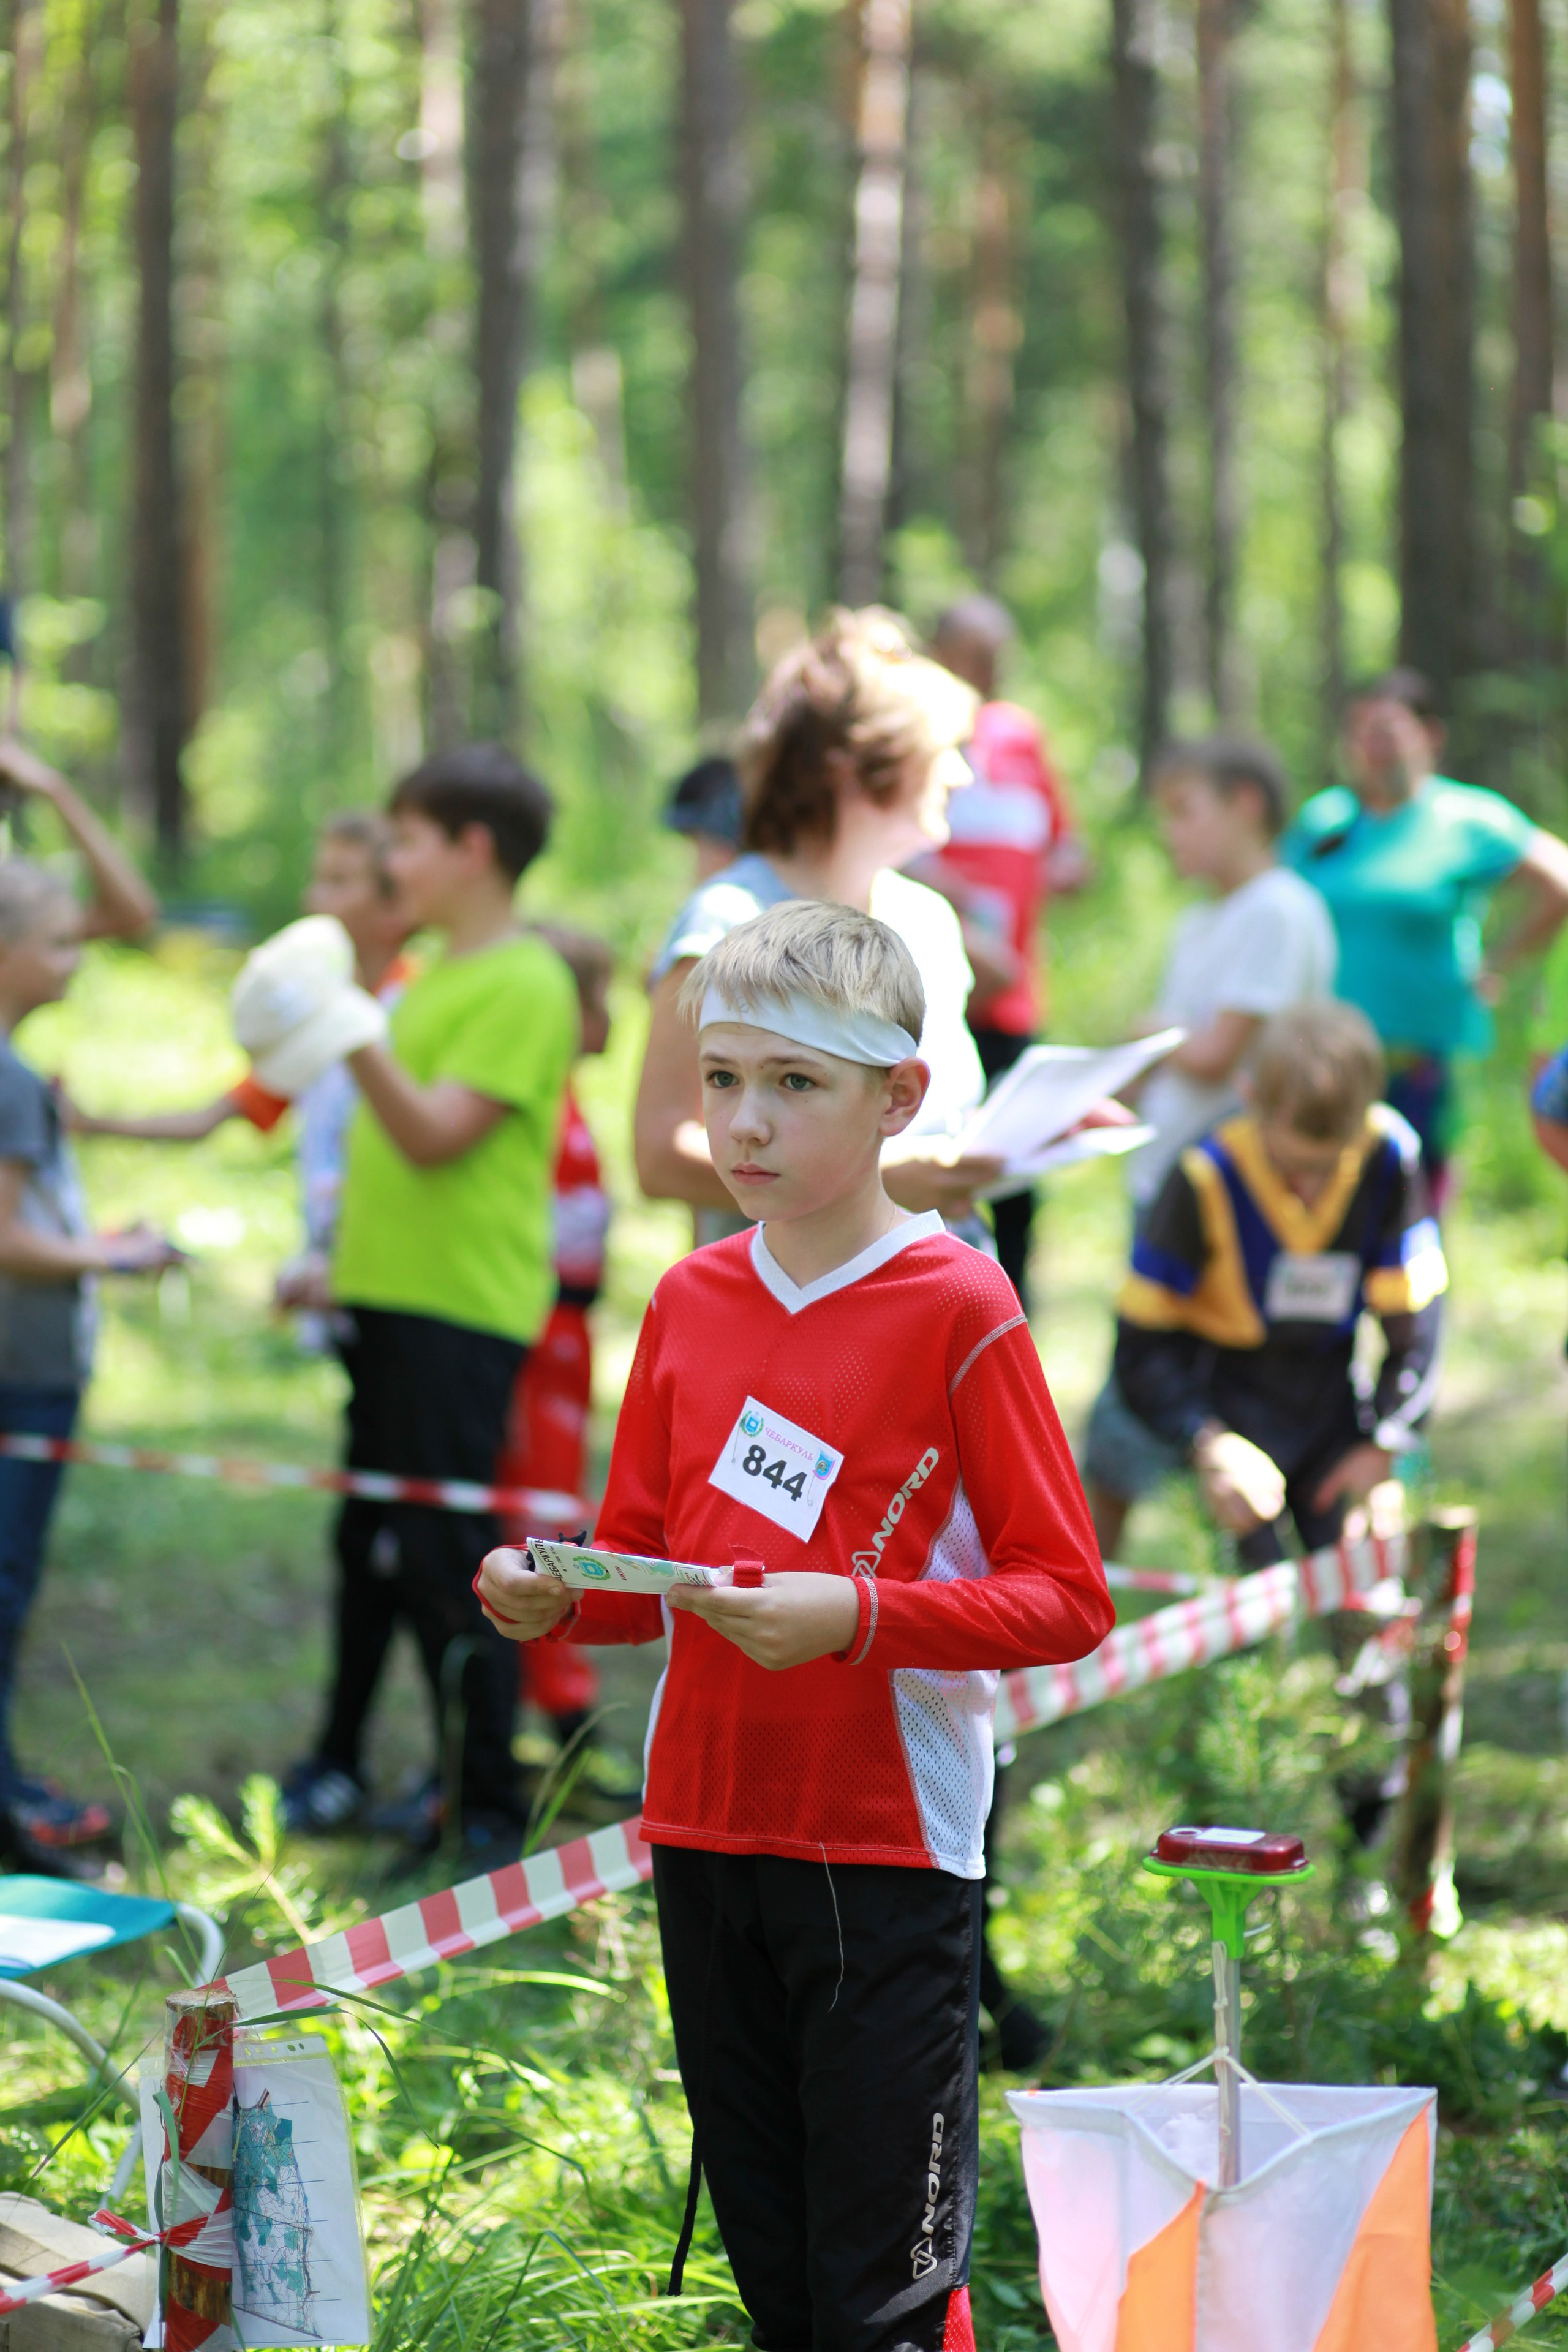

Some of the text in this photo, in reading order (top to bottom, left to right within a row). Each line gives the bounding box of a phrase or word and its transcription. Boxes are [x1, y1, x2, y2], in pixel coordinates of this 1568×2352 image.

[742, 1444, 807, 1502] 844
[765, 1427, 813, 1461] ЧЕБАРКУЛЬ
[872, 1447, 940, 1553] NORD
[921, 2113, 945, 2236] NORD
